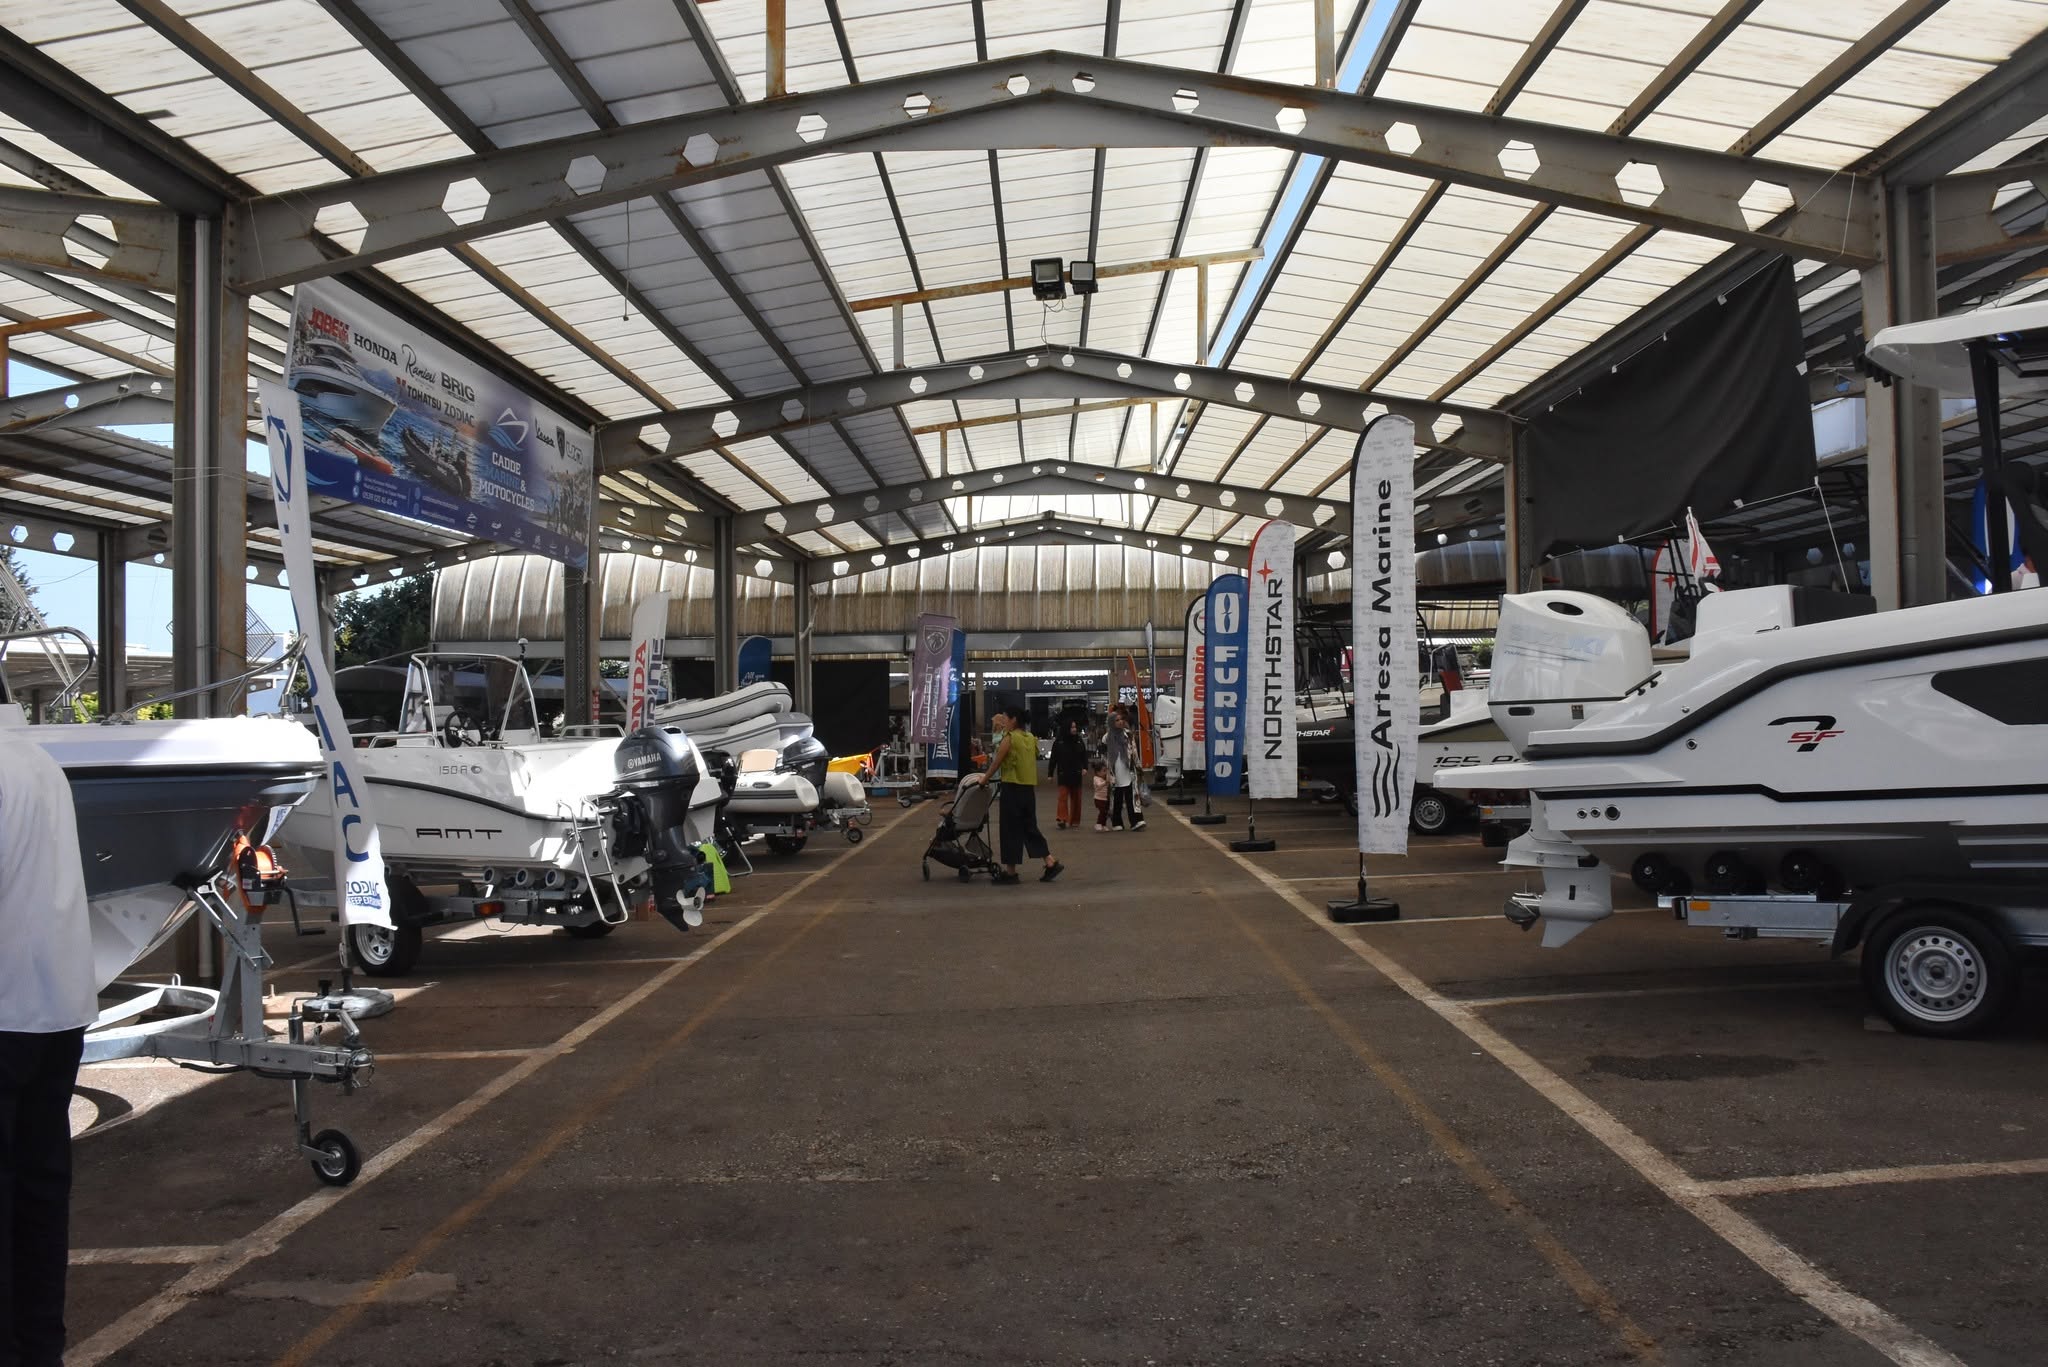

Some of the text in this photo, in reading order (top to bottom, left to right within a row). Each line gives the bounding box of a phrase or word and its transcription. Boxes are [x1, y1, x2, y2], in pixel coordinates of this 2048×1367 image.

[354, 333, 398, 365] HONDA
[441, 371, 475, 402] BRIG
[407, 385, 442, 410] TOHATSU
[444, 402, 475, 427] ZODIAC
[492, 452, 521, 475] CADDE
[480, 479, 535, 511] MOTOCYCLES
[520, 480, 527, 493] &
[1370, 478, 1392, 615] Marine
[1264, 578, 1283, 760] NORTHSTAR
[1370, 626, 1393, 750] Artesa
[921, 663, 933, 737] PEUGEOT
[1214, 646, 1239, 778] FURUNO
[1787, 730, 1845, 743] SF
[634, 752, 662, 767] YAMAHA
[416, 828, 503, 839] AMT
